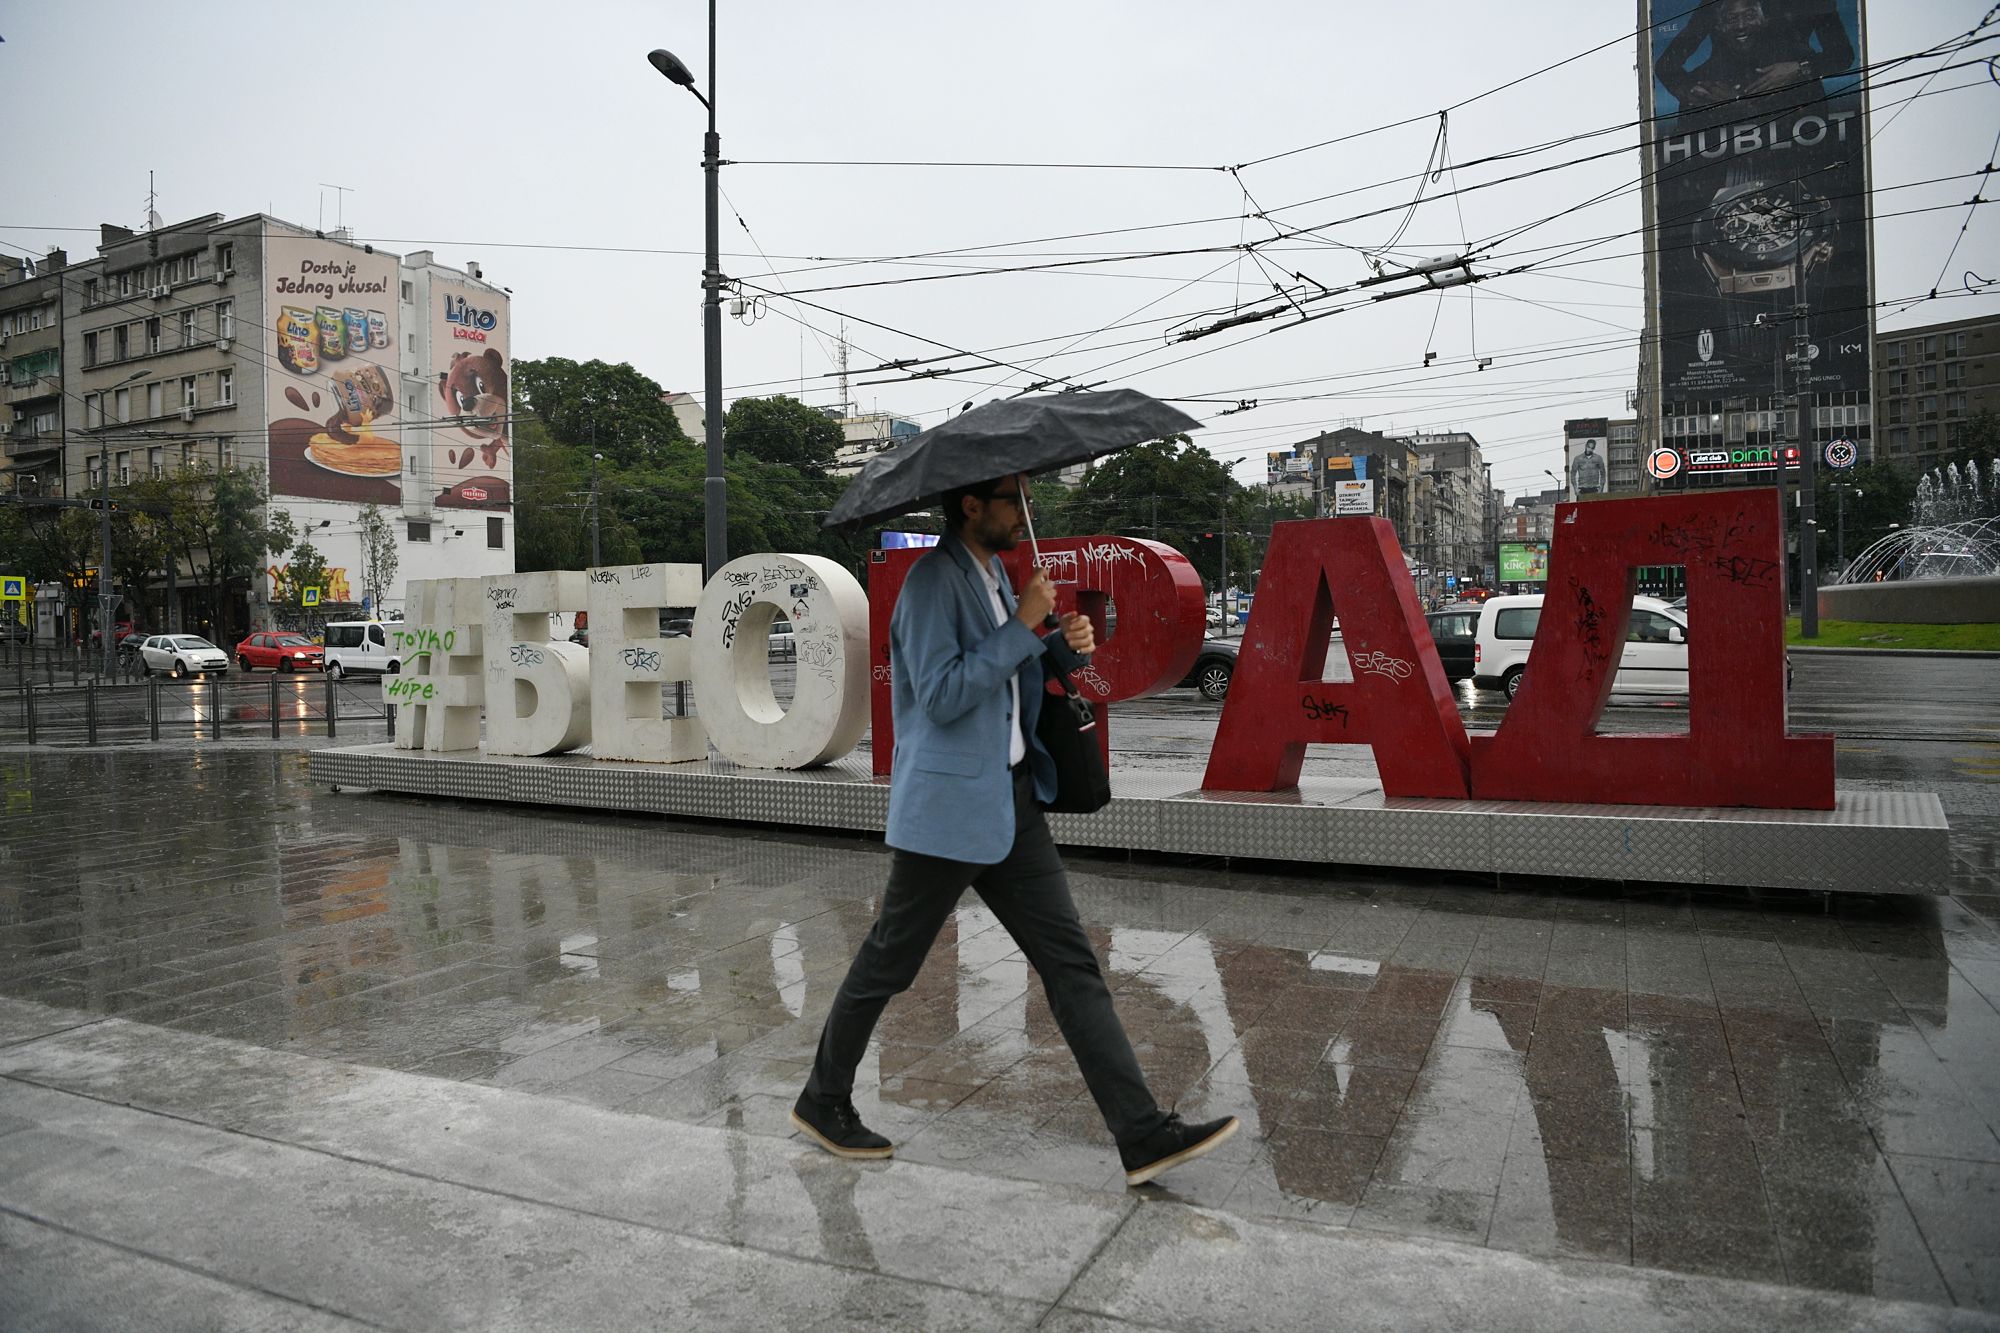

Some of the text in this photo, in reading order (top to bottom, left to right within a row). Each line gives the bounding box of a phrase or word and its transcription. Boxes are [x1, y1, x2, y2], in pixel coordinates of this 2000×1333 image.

[1658, 23, 1679, 33] PELE
[1662, 110, 1856, 165] HUBLOT
[301, 259, 357, 279] Dosta je
[276, 275, 388, 300] Jednog ukusa!
[443, 293, 497, 331] Lino
[286, 320, 310, 337] Lino
[1503, 561, 1525, 570] KING
